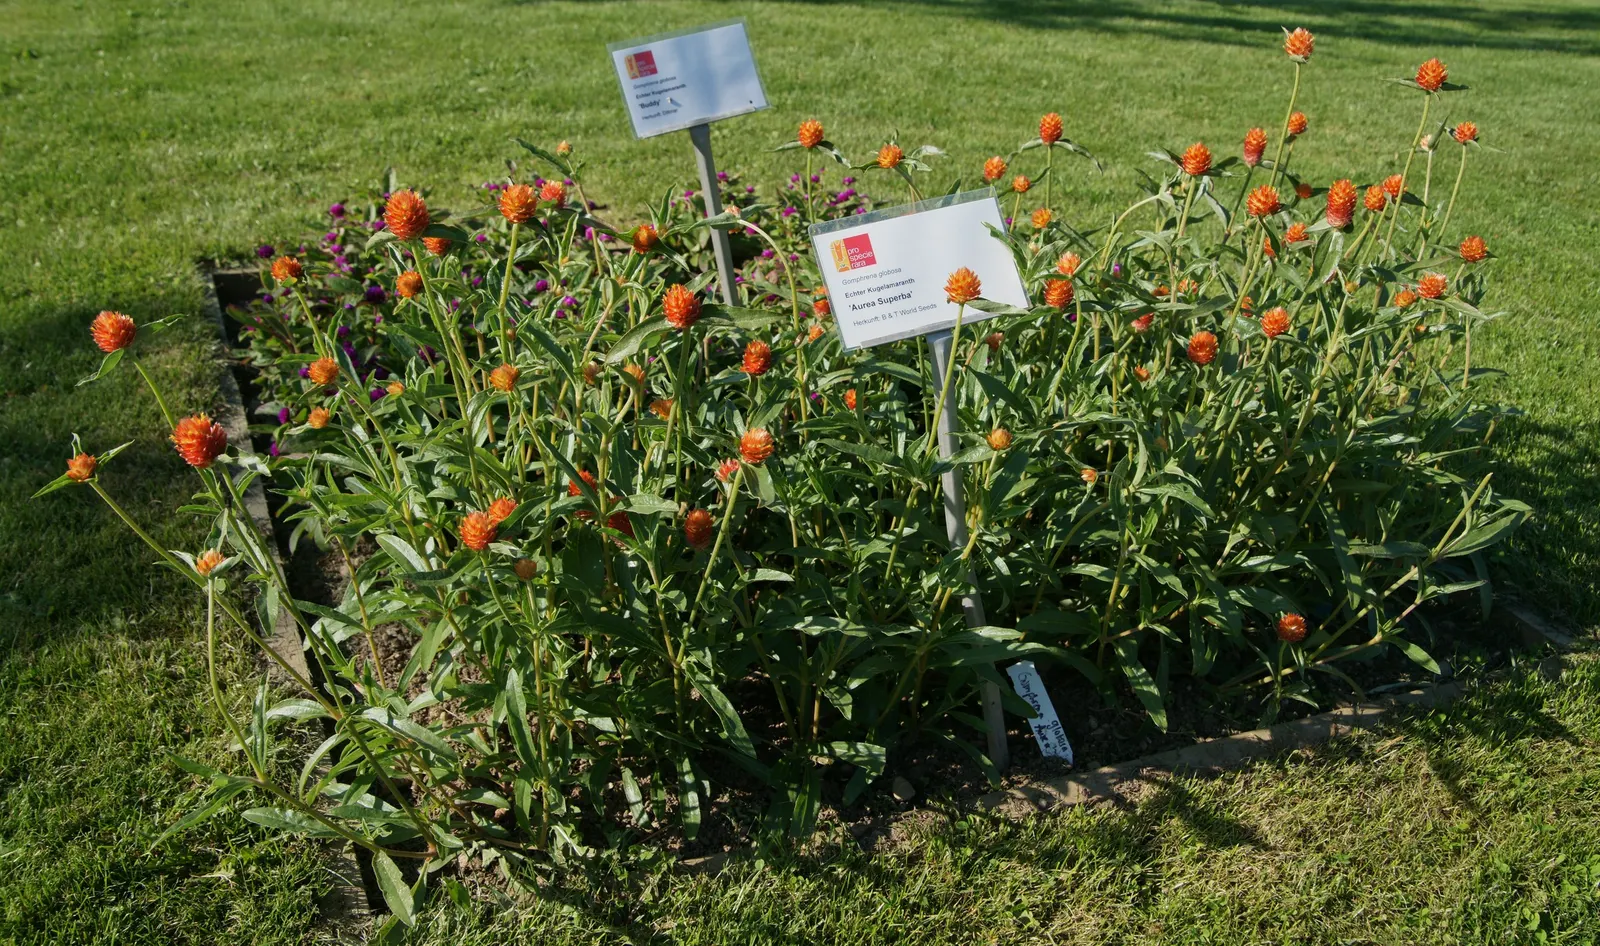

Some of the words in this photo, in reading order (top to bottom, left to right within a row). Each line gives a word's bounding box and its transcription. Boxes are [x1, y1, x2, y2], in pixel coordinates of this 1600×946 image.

[847, 247, 860, 256] pro
[849, 251, 874, 262] specie
[851, 260, 867, 269] rara
[841, 273, 878, 286] Gomphrena
[878, 267, 902, 278] globosa
[844, 288, 866, 299] Echter
[867, 278, 916, 293] Kugelamaranth
[853, 316, 880, 327] Herkunft:
[881, 313, 887, 321] B
[899, 306, 918, 316] World
[918, 303, 937, 312] Seeds
